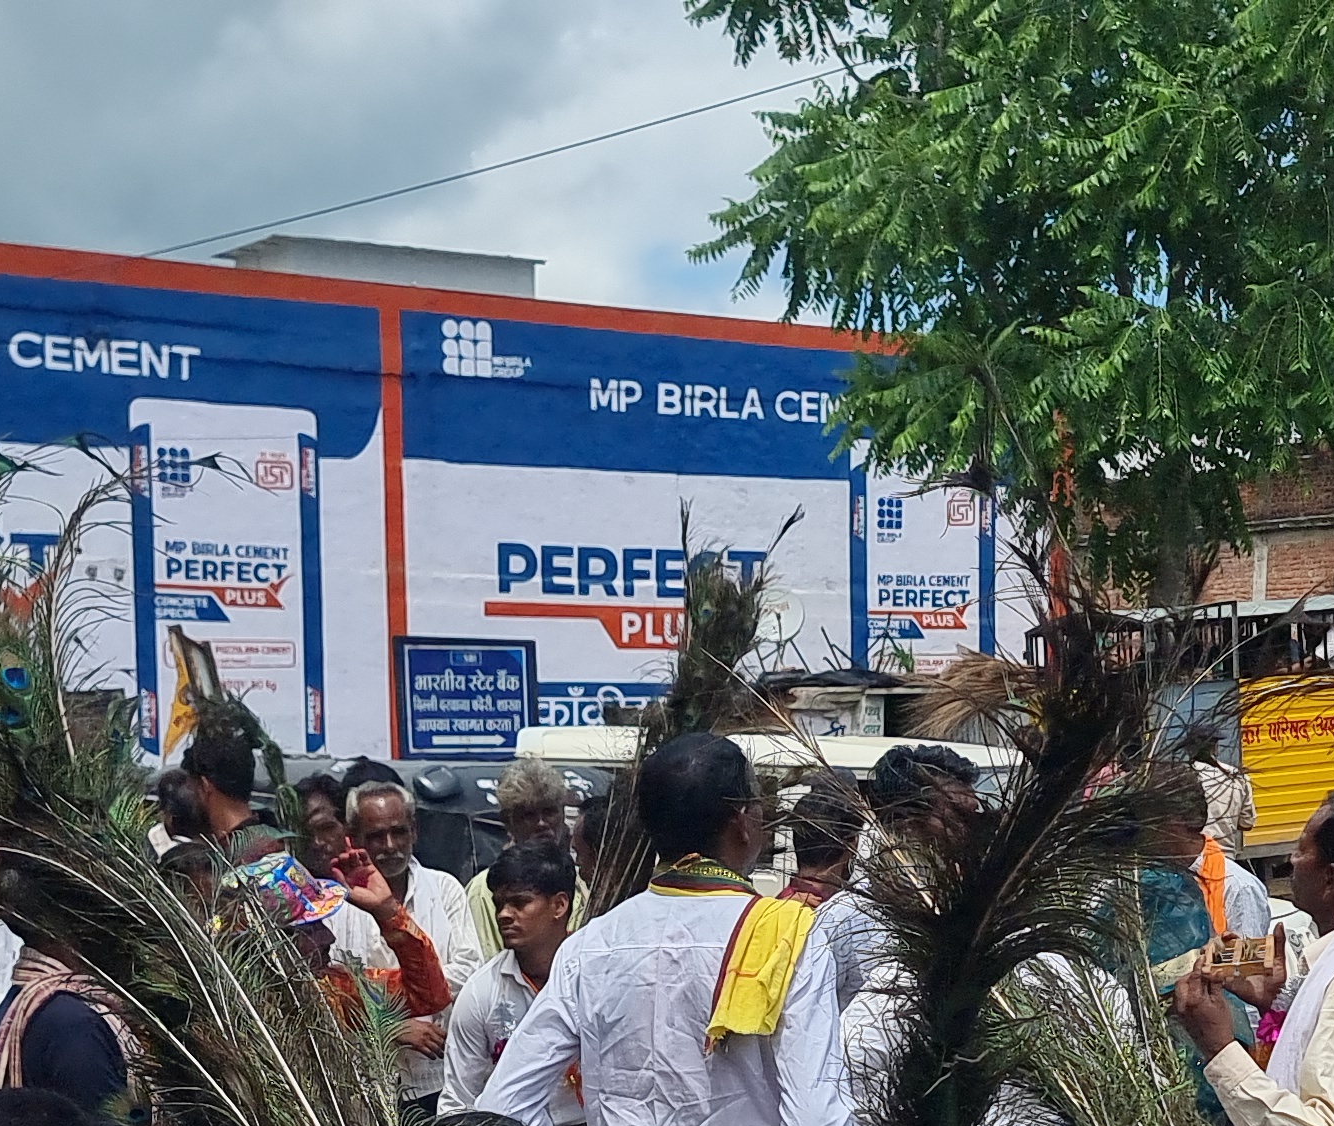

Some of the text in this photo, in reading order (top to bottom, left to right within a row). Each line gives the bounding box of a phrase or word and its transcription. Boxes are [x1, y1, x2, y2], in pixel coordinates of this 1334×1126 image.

[8, 331, 202, 381] CEMENT
[589, 377, 841, 424] MP BIRLA CEM
[165, 540, 289, 560] MP BIRLA CEMENT
[166, 559, 288, 583] PERFECT
[498, 542, 768, 598] PERFET
[877, 574, 970, 588] MP BIRLA CEMENT
[224, 588, 267, 606] PLUS
[878, 589, 970, 608] PERFECT
[621, 611, 686, 646] PLU
[922, 614, 955, 627] PLUS
[414, 668, 521, 691] भारतीय स्टेट बैंक
[415, 718, 450, 732] आपका
[452, 718, 484, 732] स्वागत
[486, 718, 512, 732] करता
[1267, 716, 1310, 742] परिषद
